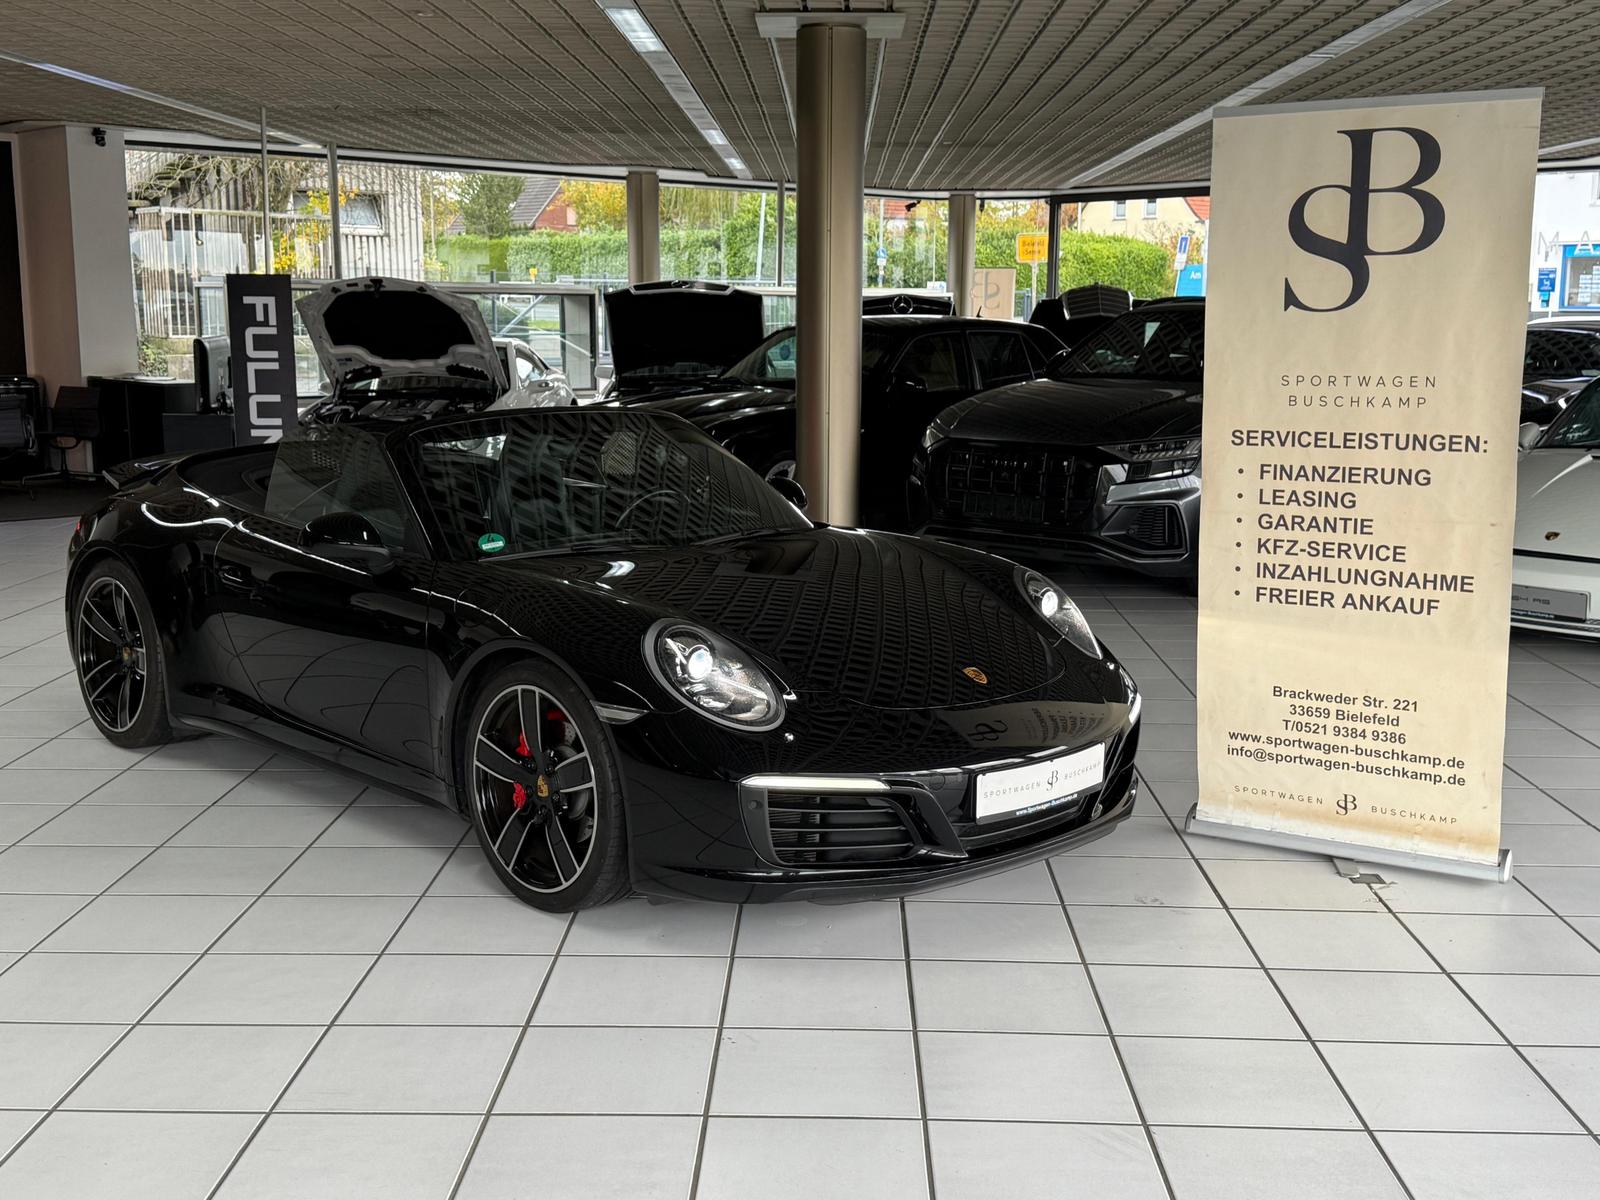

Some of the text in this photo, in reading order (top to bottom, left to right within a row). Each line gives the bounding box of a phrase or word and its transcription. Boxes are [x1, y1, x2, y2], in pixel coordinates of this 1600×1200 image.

[1281, 374, 1437, 389] SPORTWAGEN
[1288, 394, 1427, 409] BUSCHKAMP
[1230, 429, 1489, 454] SERVICELEISTUNGEN:
[1259, 463, 1432, 486] FINANZIERUNG
[1258, 488, 1357, 509] LEASING
[1257, 513, 1374, 535] GARANTIE
[1256, 538, 1407, 563] KFZ-SERVICE
[1256, 562, 1475, 593] INZAHLUNGNAHME
[1255, 586, 1441, 616] FREIER ANKAUF
[1272, 685, 1419, 713] Brackweder Str. 221
[1289, 704, 1400, 728] 33659 Bielefeld
[1282, 719, 1407, 745] T/0521 9384 9386
[1228, 731, 1465, 770] www.sportwagen-buschkamp.de
[1227, 744, 1466, 786] info@sportwagen-buschkamp.de
[1234, 785, 1323, 805] SPORTWAGEN
[1371, 805, 1457, 825] BUSCHKAMP
